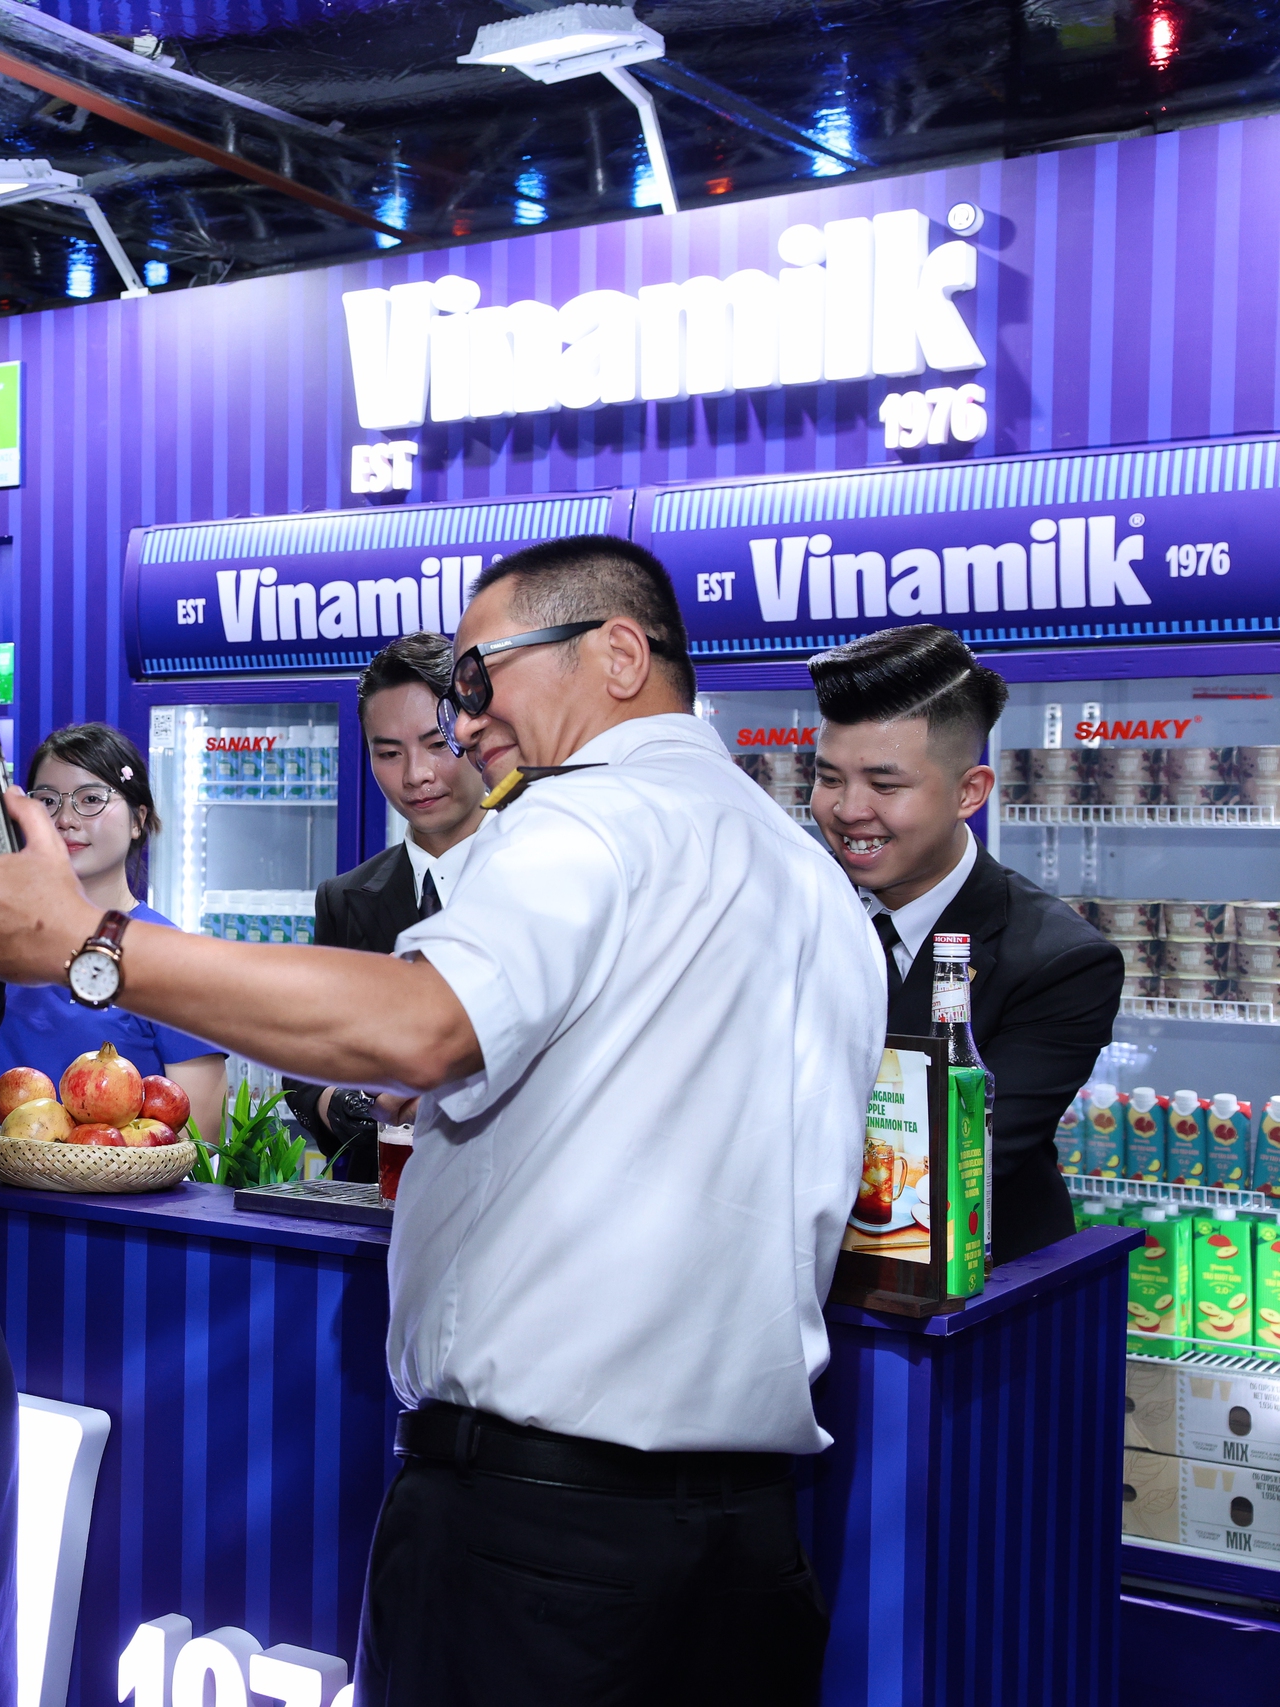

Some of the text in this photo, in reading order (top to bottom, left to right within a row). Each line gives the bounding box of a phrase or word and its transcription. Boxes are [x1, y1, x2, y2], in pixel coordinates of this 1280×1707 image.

[342, 208, 986, 430] Vinamilk
[879, 384, 987, 450] 1976
[350, 440, 418, 494] EST
[696, 514, 1230, 622] EST Vinamilk 1976
[176, 598, 206, 625] EST
[736, 726, 818, 746] SANAK
[1074, 718, 1192, 741] SANAKY
[206, 736, 277, 752] SANAKY
[871, 1090, 904, 1104] NGARIAN
[866, 1102, 885, 1115] PPLE
[866, 1116, 918, 1133] INNAMON TEA
[1223, 1440, 1249, 1462] MIX
[1226, 1530, 1252, 1552] MIX
